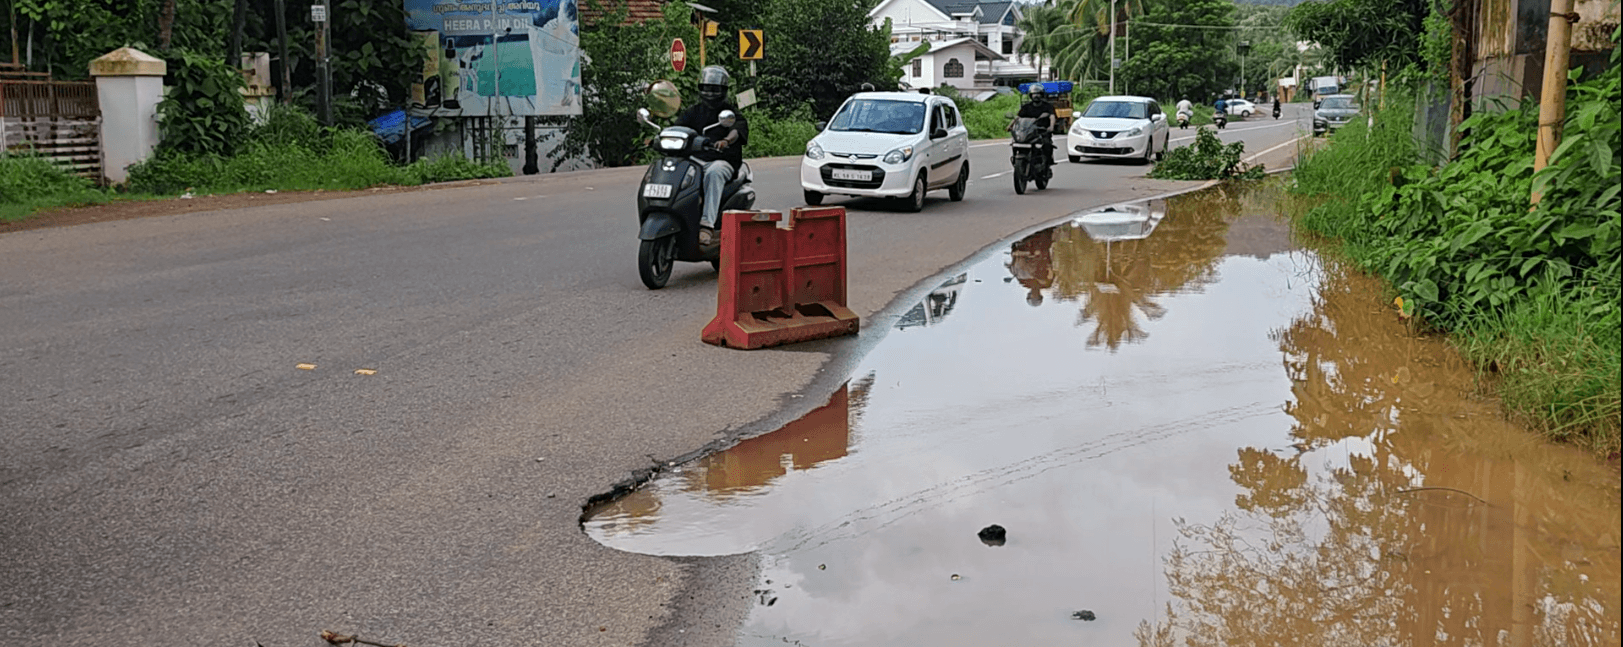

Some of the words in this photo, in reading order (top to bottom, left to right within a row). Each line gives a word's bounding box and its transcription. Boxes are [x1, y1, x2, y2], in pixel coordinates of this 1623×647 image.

[444, 19, 480, 31] HEERA
[484, 19, 510, 30] PIN
[673, 51, 684, 61] STOP
